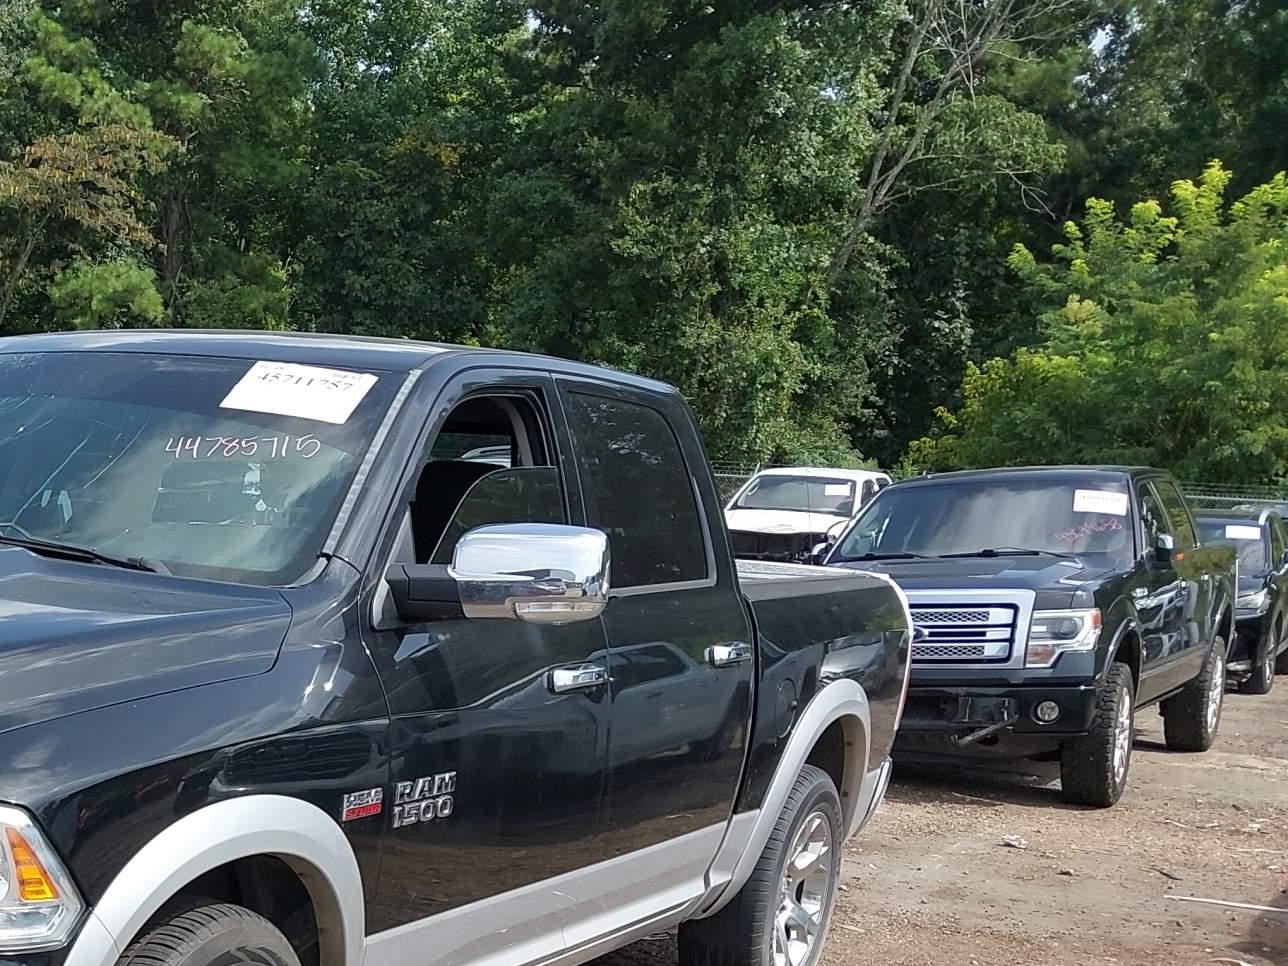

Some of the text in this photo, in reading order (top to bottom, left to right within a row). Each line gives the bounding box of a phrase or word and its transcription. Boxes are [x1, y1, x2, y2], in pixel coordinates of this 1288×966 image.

[165, 433, 321, 459] 44785715
[395, 771, 457, 805] RAM
[392, 794, 454, 829] 1500
